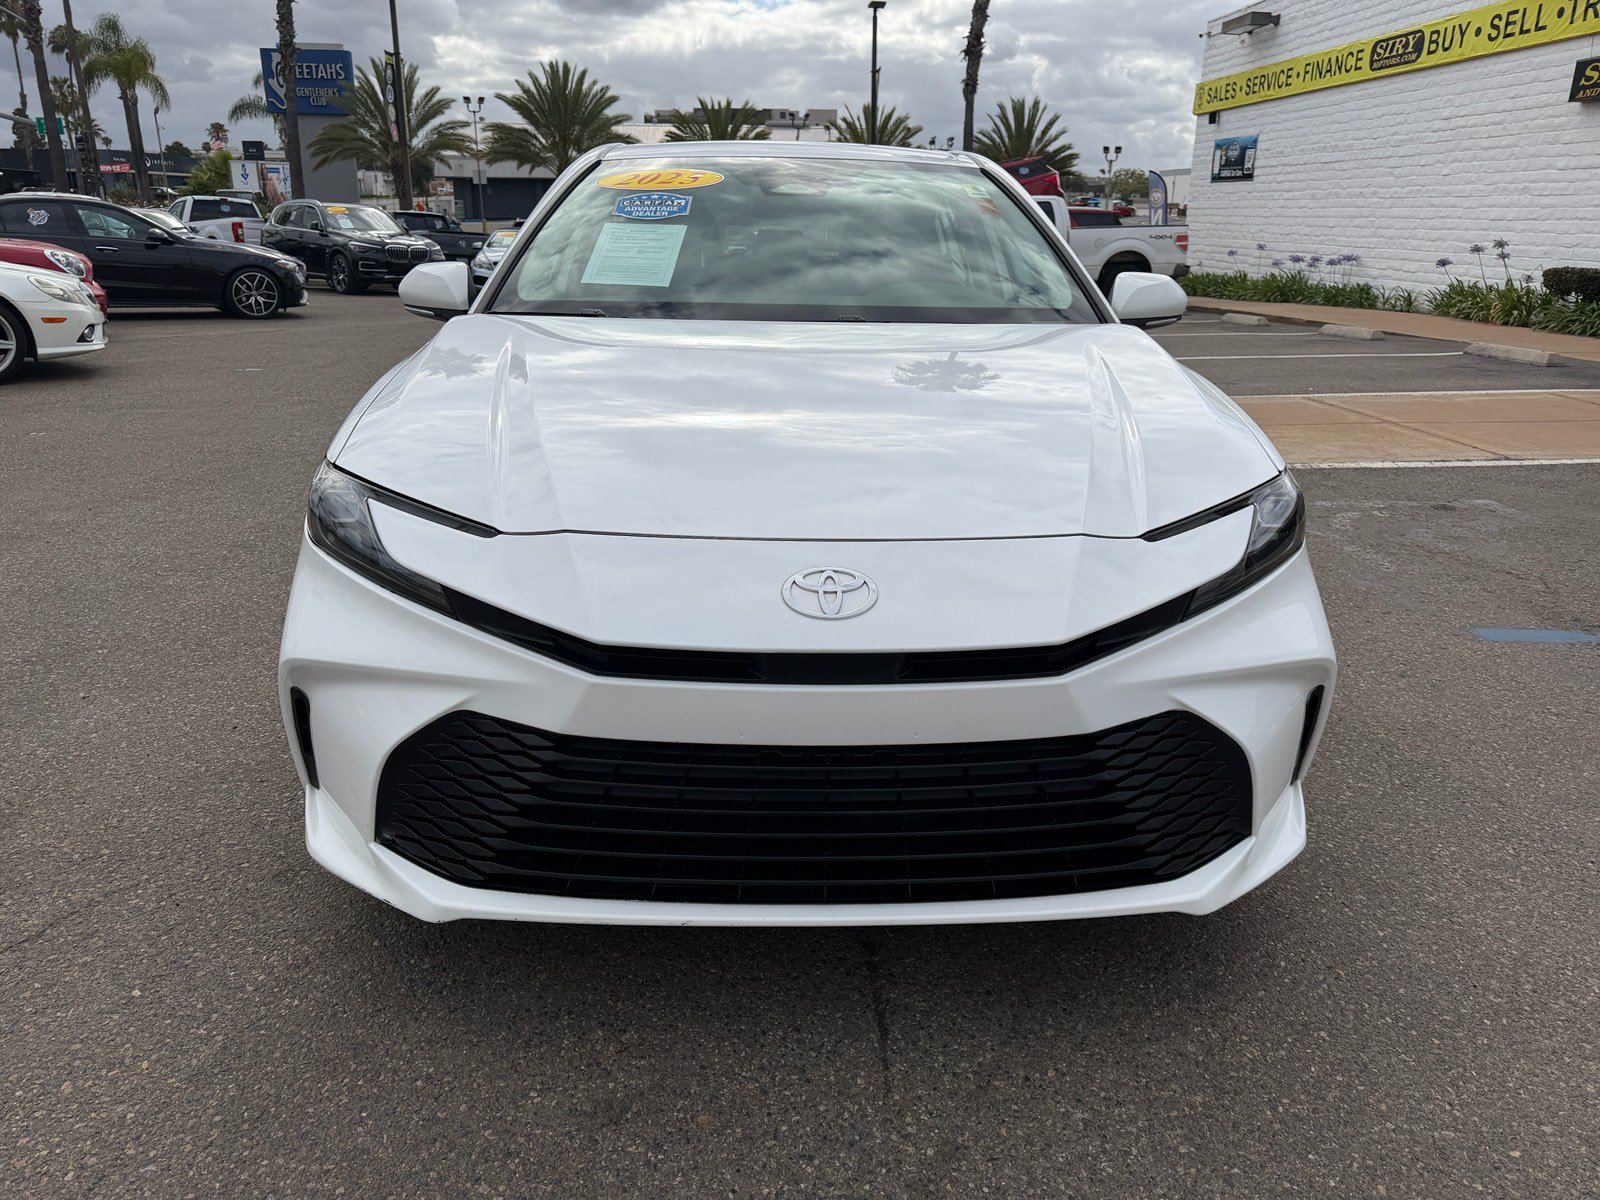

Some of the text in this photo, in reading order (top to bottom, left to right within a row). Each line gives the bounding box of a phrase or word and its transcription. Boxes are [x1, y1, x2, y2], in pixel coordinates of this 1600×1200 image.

[1426, 21, 1472, 56] BUY
[1487, 3, 1548, 43] SELL
[1373, 33, 1423, 61] SIRY
[1206, 48, 1365, 105] SALES SERVICE FINANCE
[296, 87, 339, 98] GENTLEMEN'S
[310, 96, 327, 106] CLUB
[615, 171, 706, 187] 2025
